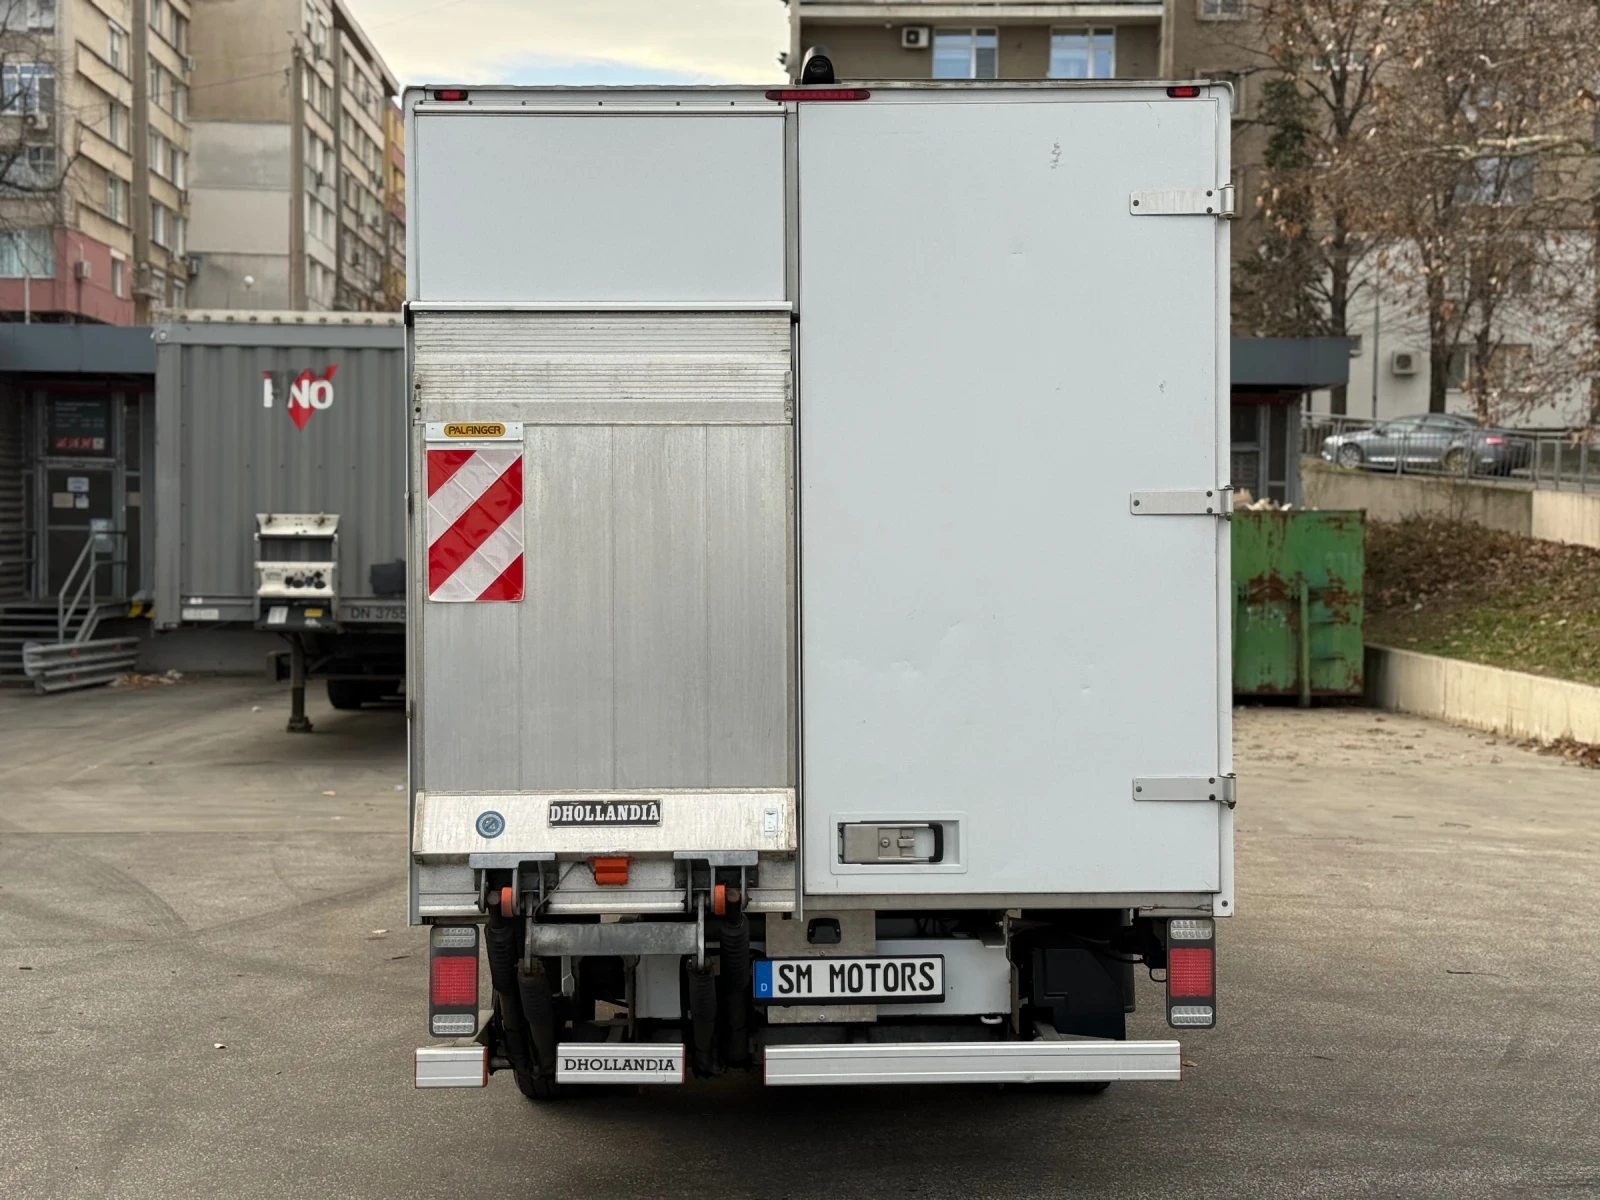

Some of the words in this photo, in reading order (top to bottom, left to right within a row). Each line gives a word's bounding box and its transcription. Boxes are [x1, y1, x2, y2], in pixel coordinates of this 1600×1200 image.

[448, 425, 502, 435] PALFINGER
[351, 607, 371, 619] DN
[549, 804, 658, 823] DHOLLANDIA
[760, 983, 769, 992] D
[778, 964, 812, 994] SM
[829, 962, 935, 993] MOTORS
[564, 1058, 677, 1072] DHOLLANDIA
